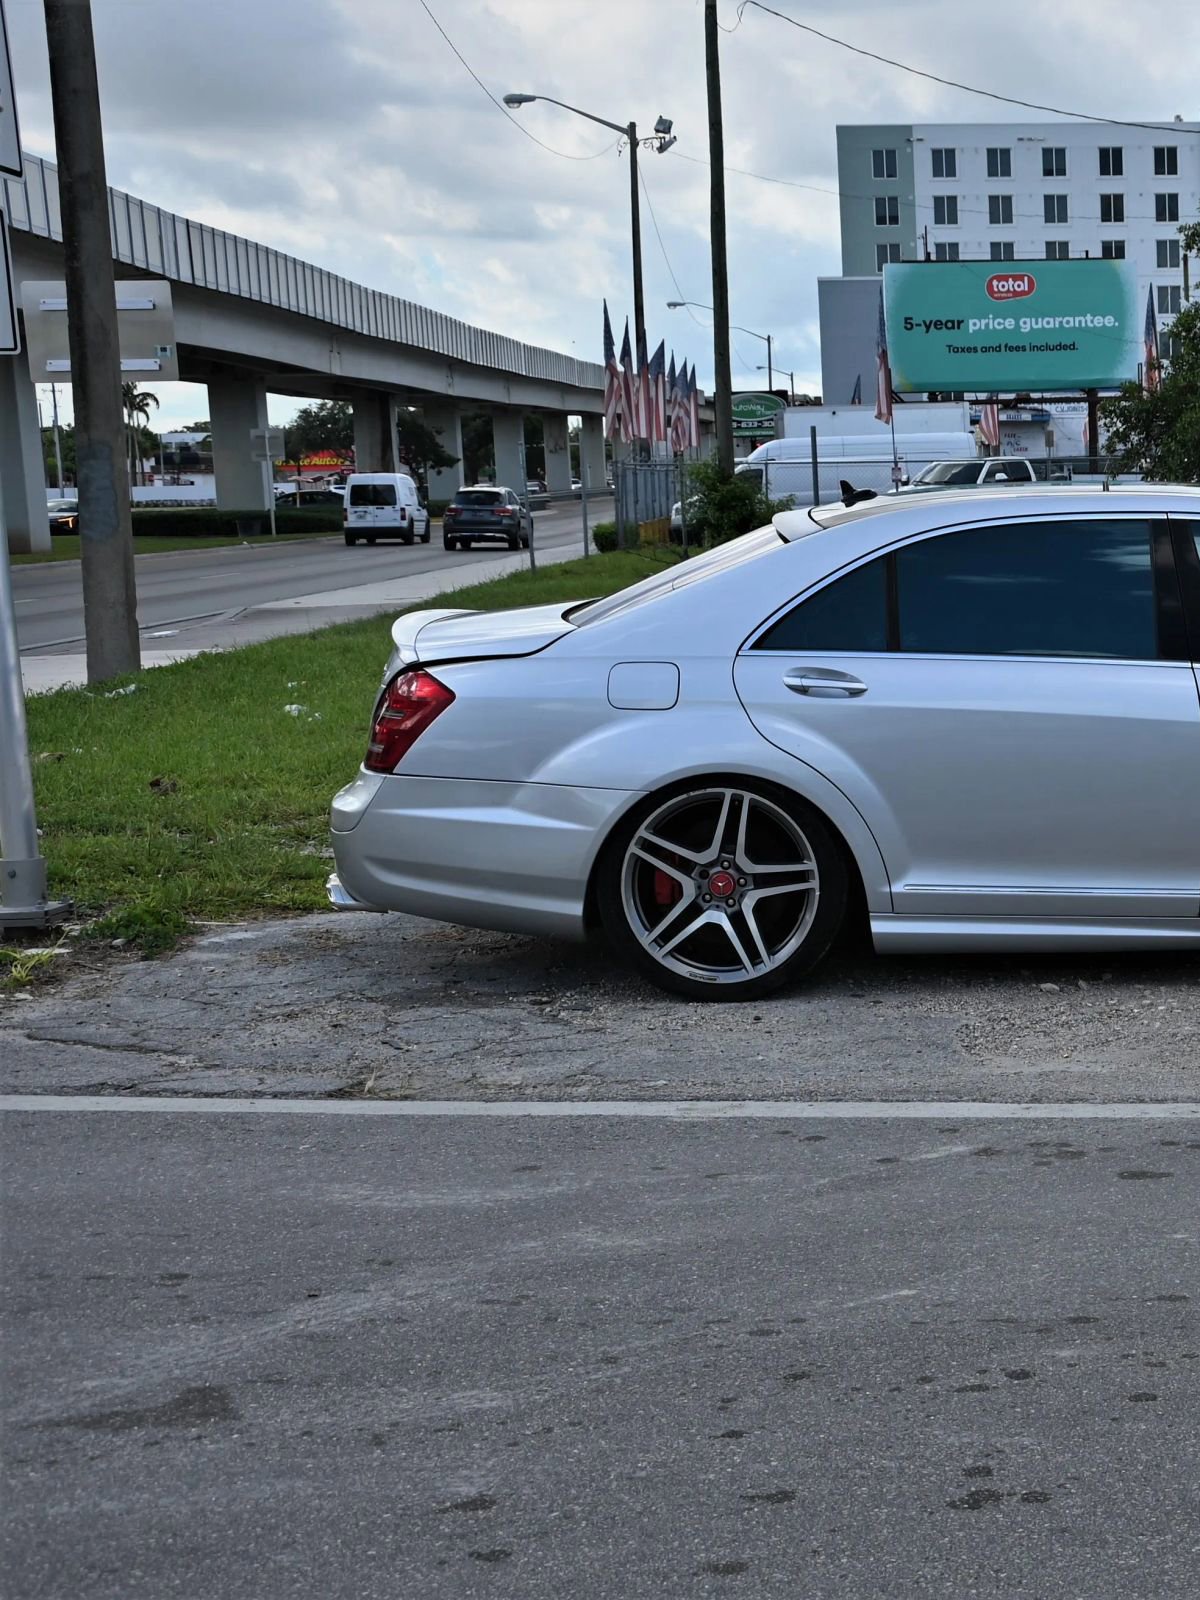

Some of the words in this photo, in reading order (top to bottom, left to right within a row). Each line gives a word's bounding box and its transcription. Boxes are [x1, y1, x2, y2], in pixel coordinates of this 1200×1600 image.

[992, 276, 1029, 292] total
[903, 316, 965, 334] 5-year
[968, 314, 1015, 333] price
[1019, 312, 1119, 332] guarantee.
[946, 343, 978, 354] Taxes
[980, 343, 1002, 353] and
[1004, 342, 1027, 353] fees
[1029, 341, 1079, 352] included.
